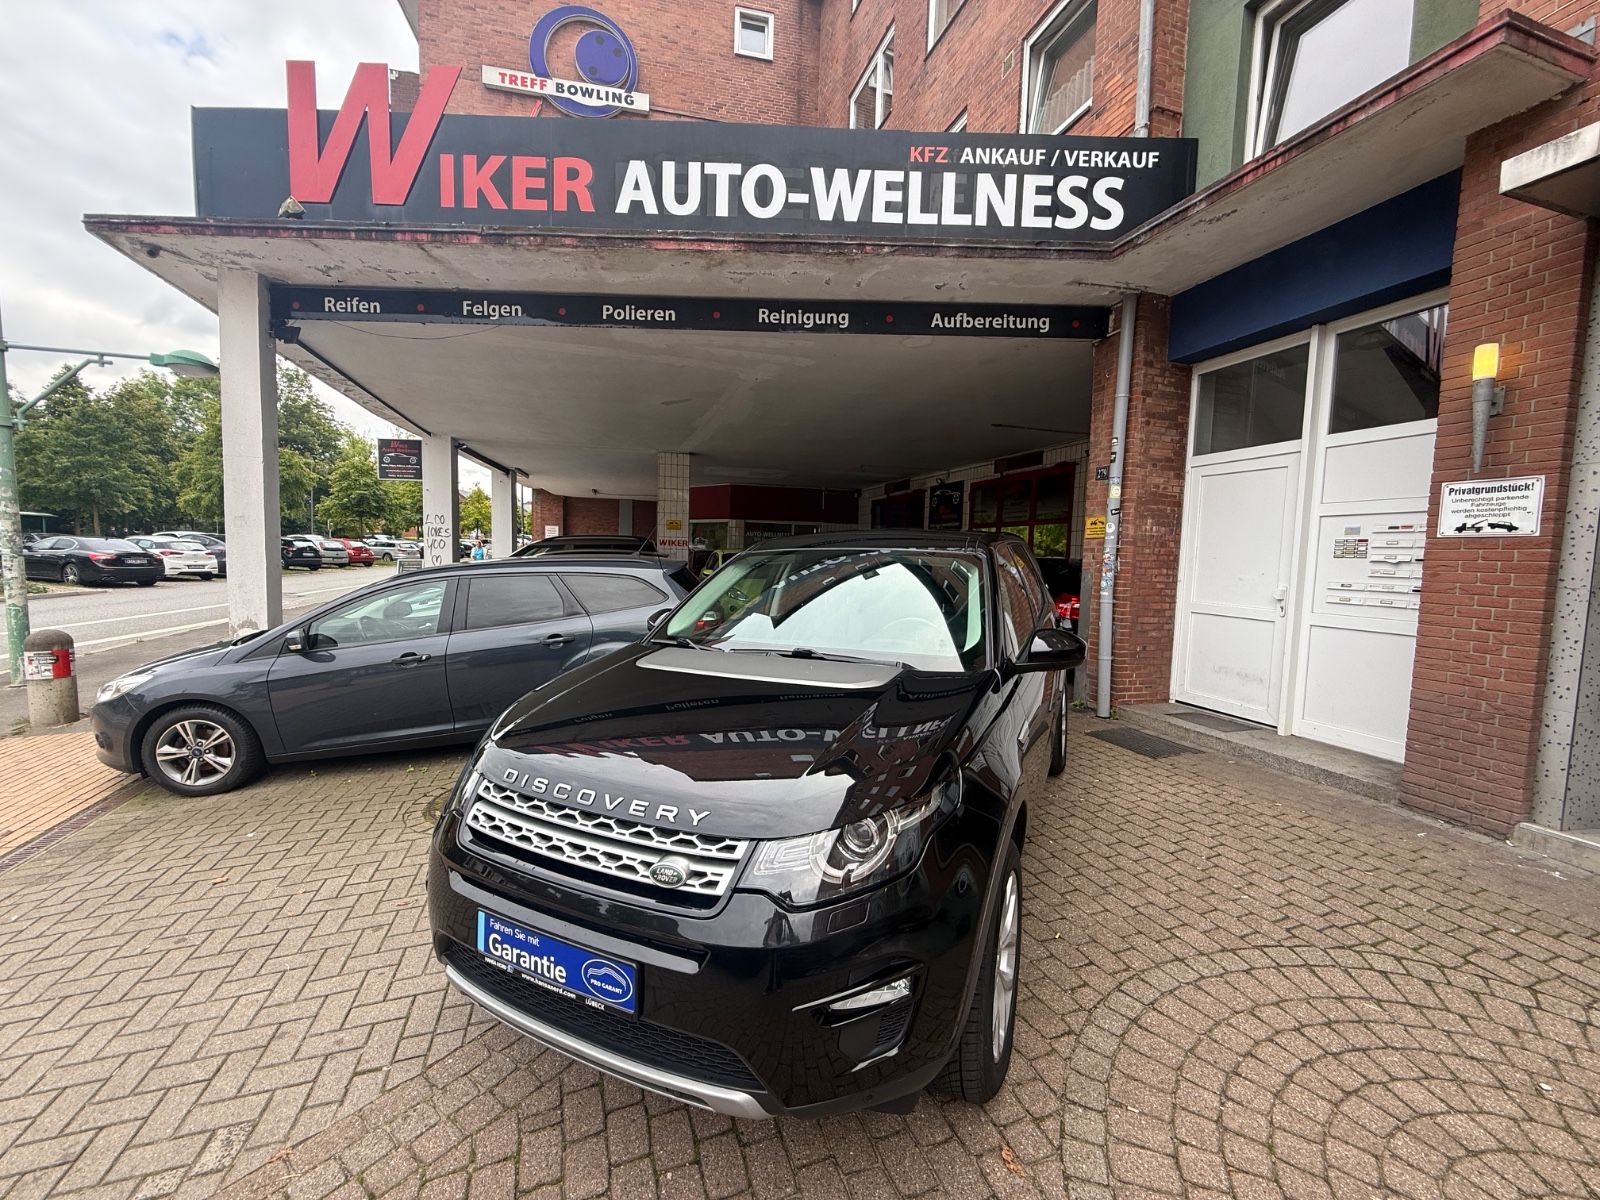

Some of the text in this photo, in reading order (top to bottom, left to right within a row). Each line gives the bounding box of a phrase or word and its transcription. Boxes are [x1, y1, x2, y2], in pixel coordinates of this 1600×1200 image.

[498, 72, 635, 106] TREFF BOWLING
[286, 60, 596, 213] WIKER
[910, 146, 948, 163] KFZ
[960, 147, 1047, 166] ANKAUF
[1064, 150, 1160, 168] VERKAUF
[614, 160, 1125, 231] AUTO-WELLNESS
[324, 297, 381, 314] Reifen
[462, 301, 523, 319] Felgen
[602, 305, 676, 322] Polieren
[758, 308, 850, 329] Reinigung
[931, 312, 1050, 334] Aufbereitung
[1448, 482, 1535, 496] Privatgrundstück!
[659, 538, 688, 547] WIKER
[503, 768, 711, 826] DISCOVERY
[656, 867, 674, 876] LAND
[656, 874, 678, 883] ROVER
[489, 918, 540, 947] Fahren Sie mit
[488, 933, 567, 983] Garantie
[590, 979, 623, 995] PRO GARANT
